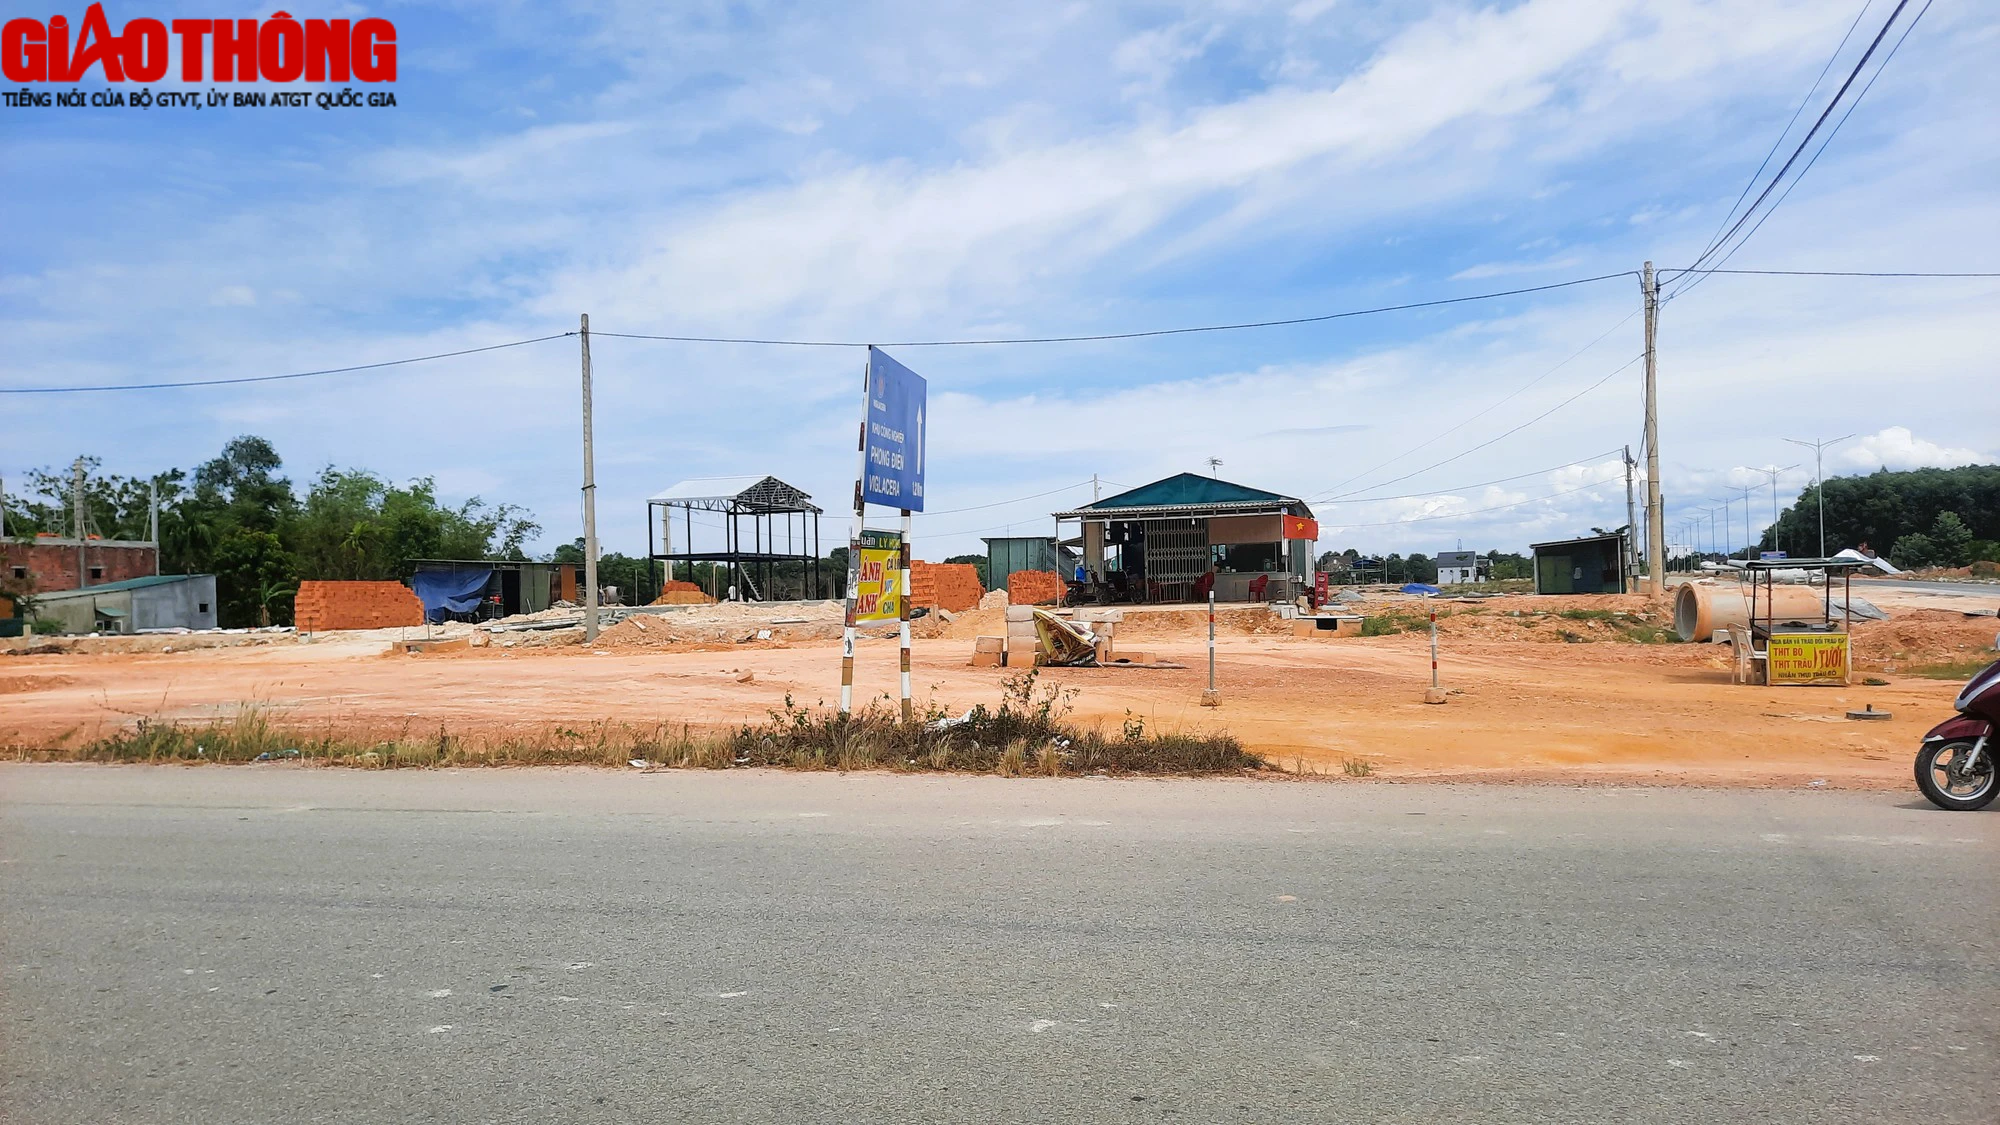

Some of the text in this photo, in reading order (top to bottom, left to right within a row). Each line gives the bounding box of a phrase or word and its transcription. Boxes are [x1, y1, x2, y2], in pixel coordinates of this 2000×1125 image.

[871, 445, 890, 467] PHONG
[869, 474, 900, 497] VIGLACERA
[861, 534, 876, 546] uán
[859, 555, 881, 582] ÁNH
[857, 594, 878, 614] ANH
